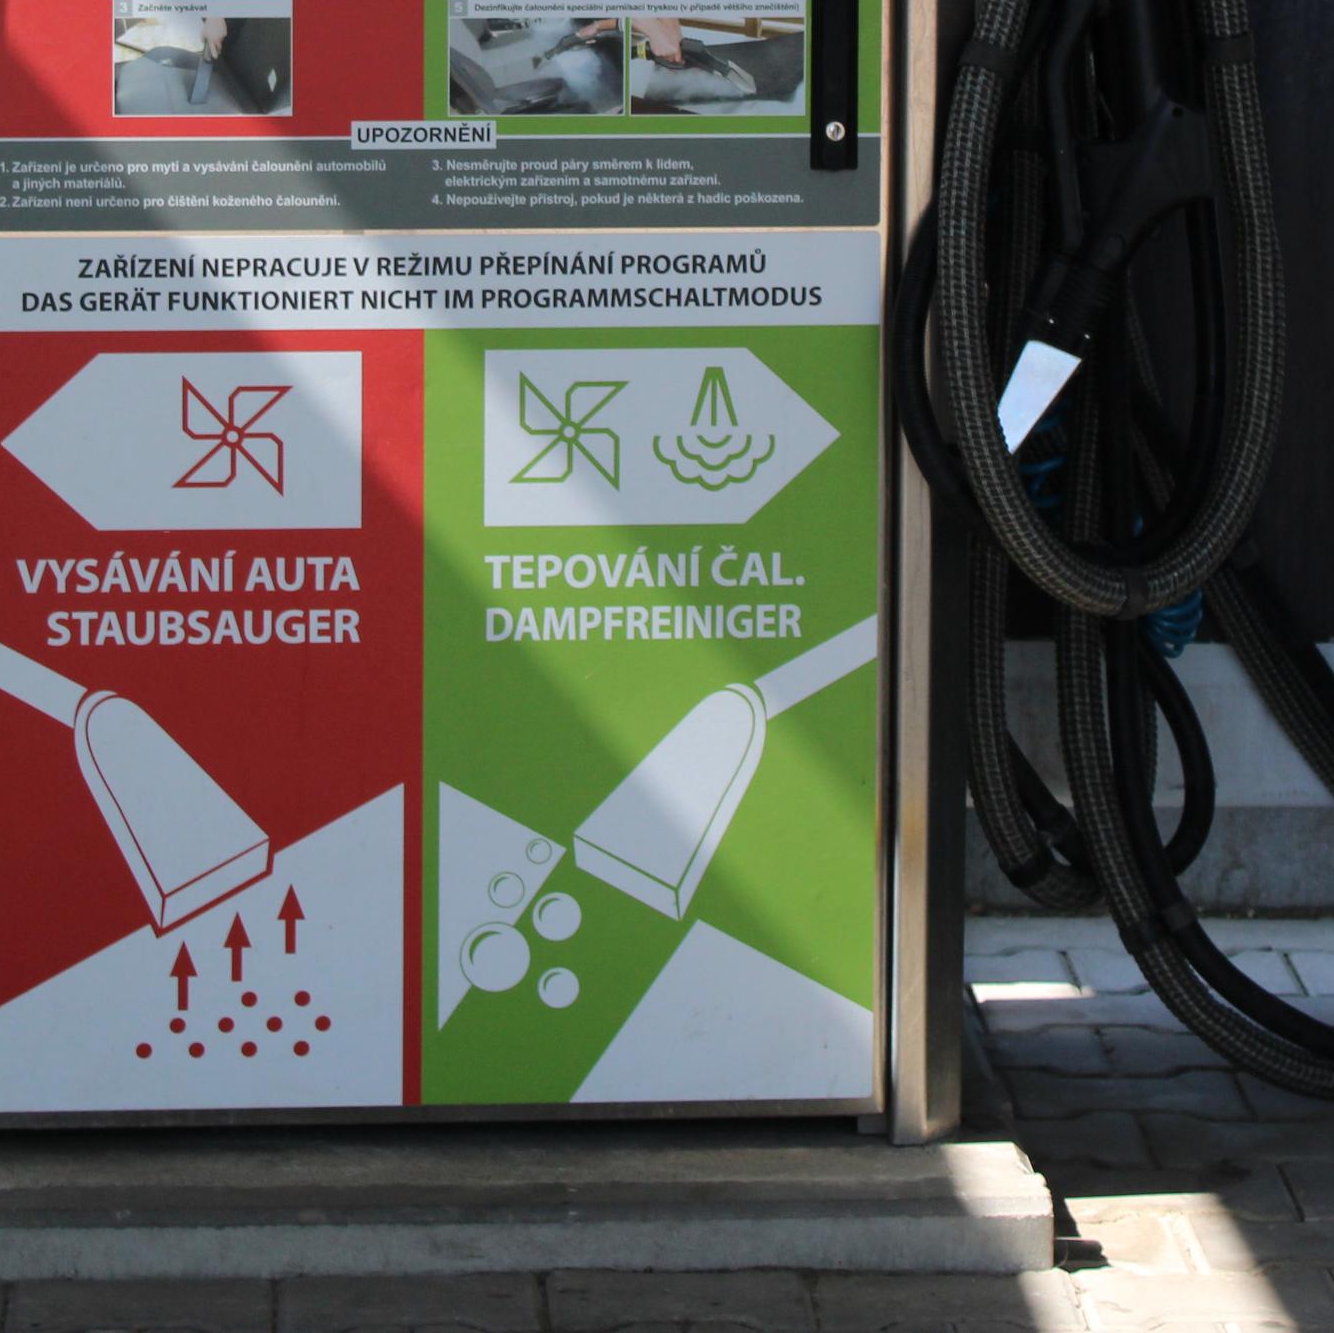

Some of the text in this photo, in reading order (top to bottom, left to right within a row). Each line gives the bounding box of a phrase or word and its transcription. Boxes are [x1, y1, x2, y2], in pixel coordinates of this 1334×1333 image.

[357, 122, 491, 145] UPOZORNĚNÍ
[432, 158, 693, 173] 3. Nesměrujte proud páry směrem k lidem,
[78, 248, 765, 279] ZAŘÍZENÍ NEPRACUJE V REŽIMU PŘEPÍNÁNÍ PROGRAMŮ
[22, 286, 822, 312] DAS GERÄT FUNKTIONIERT NICHT IM PROGRAMMSCHALTMODUS
[16, 550, 360, 593] VYSÁVÁNÍ AUTA
[484, 544, 805, 589] TEPOVÁNÍ ČAL.
[47, 609, 360, 646] STAUBSAUGER
[486, 603, 801, 641] DAMPFREINIGER
